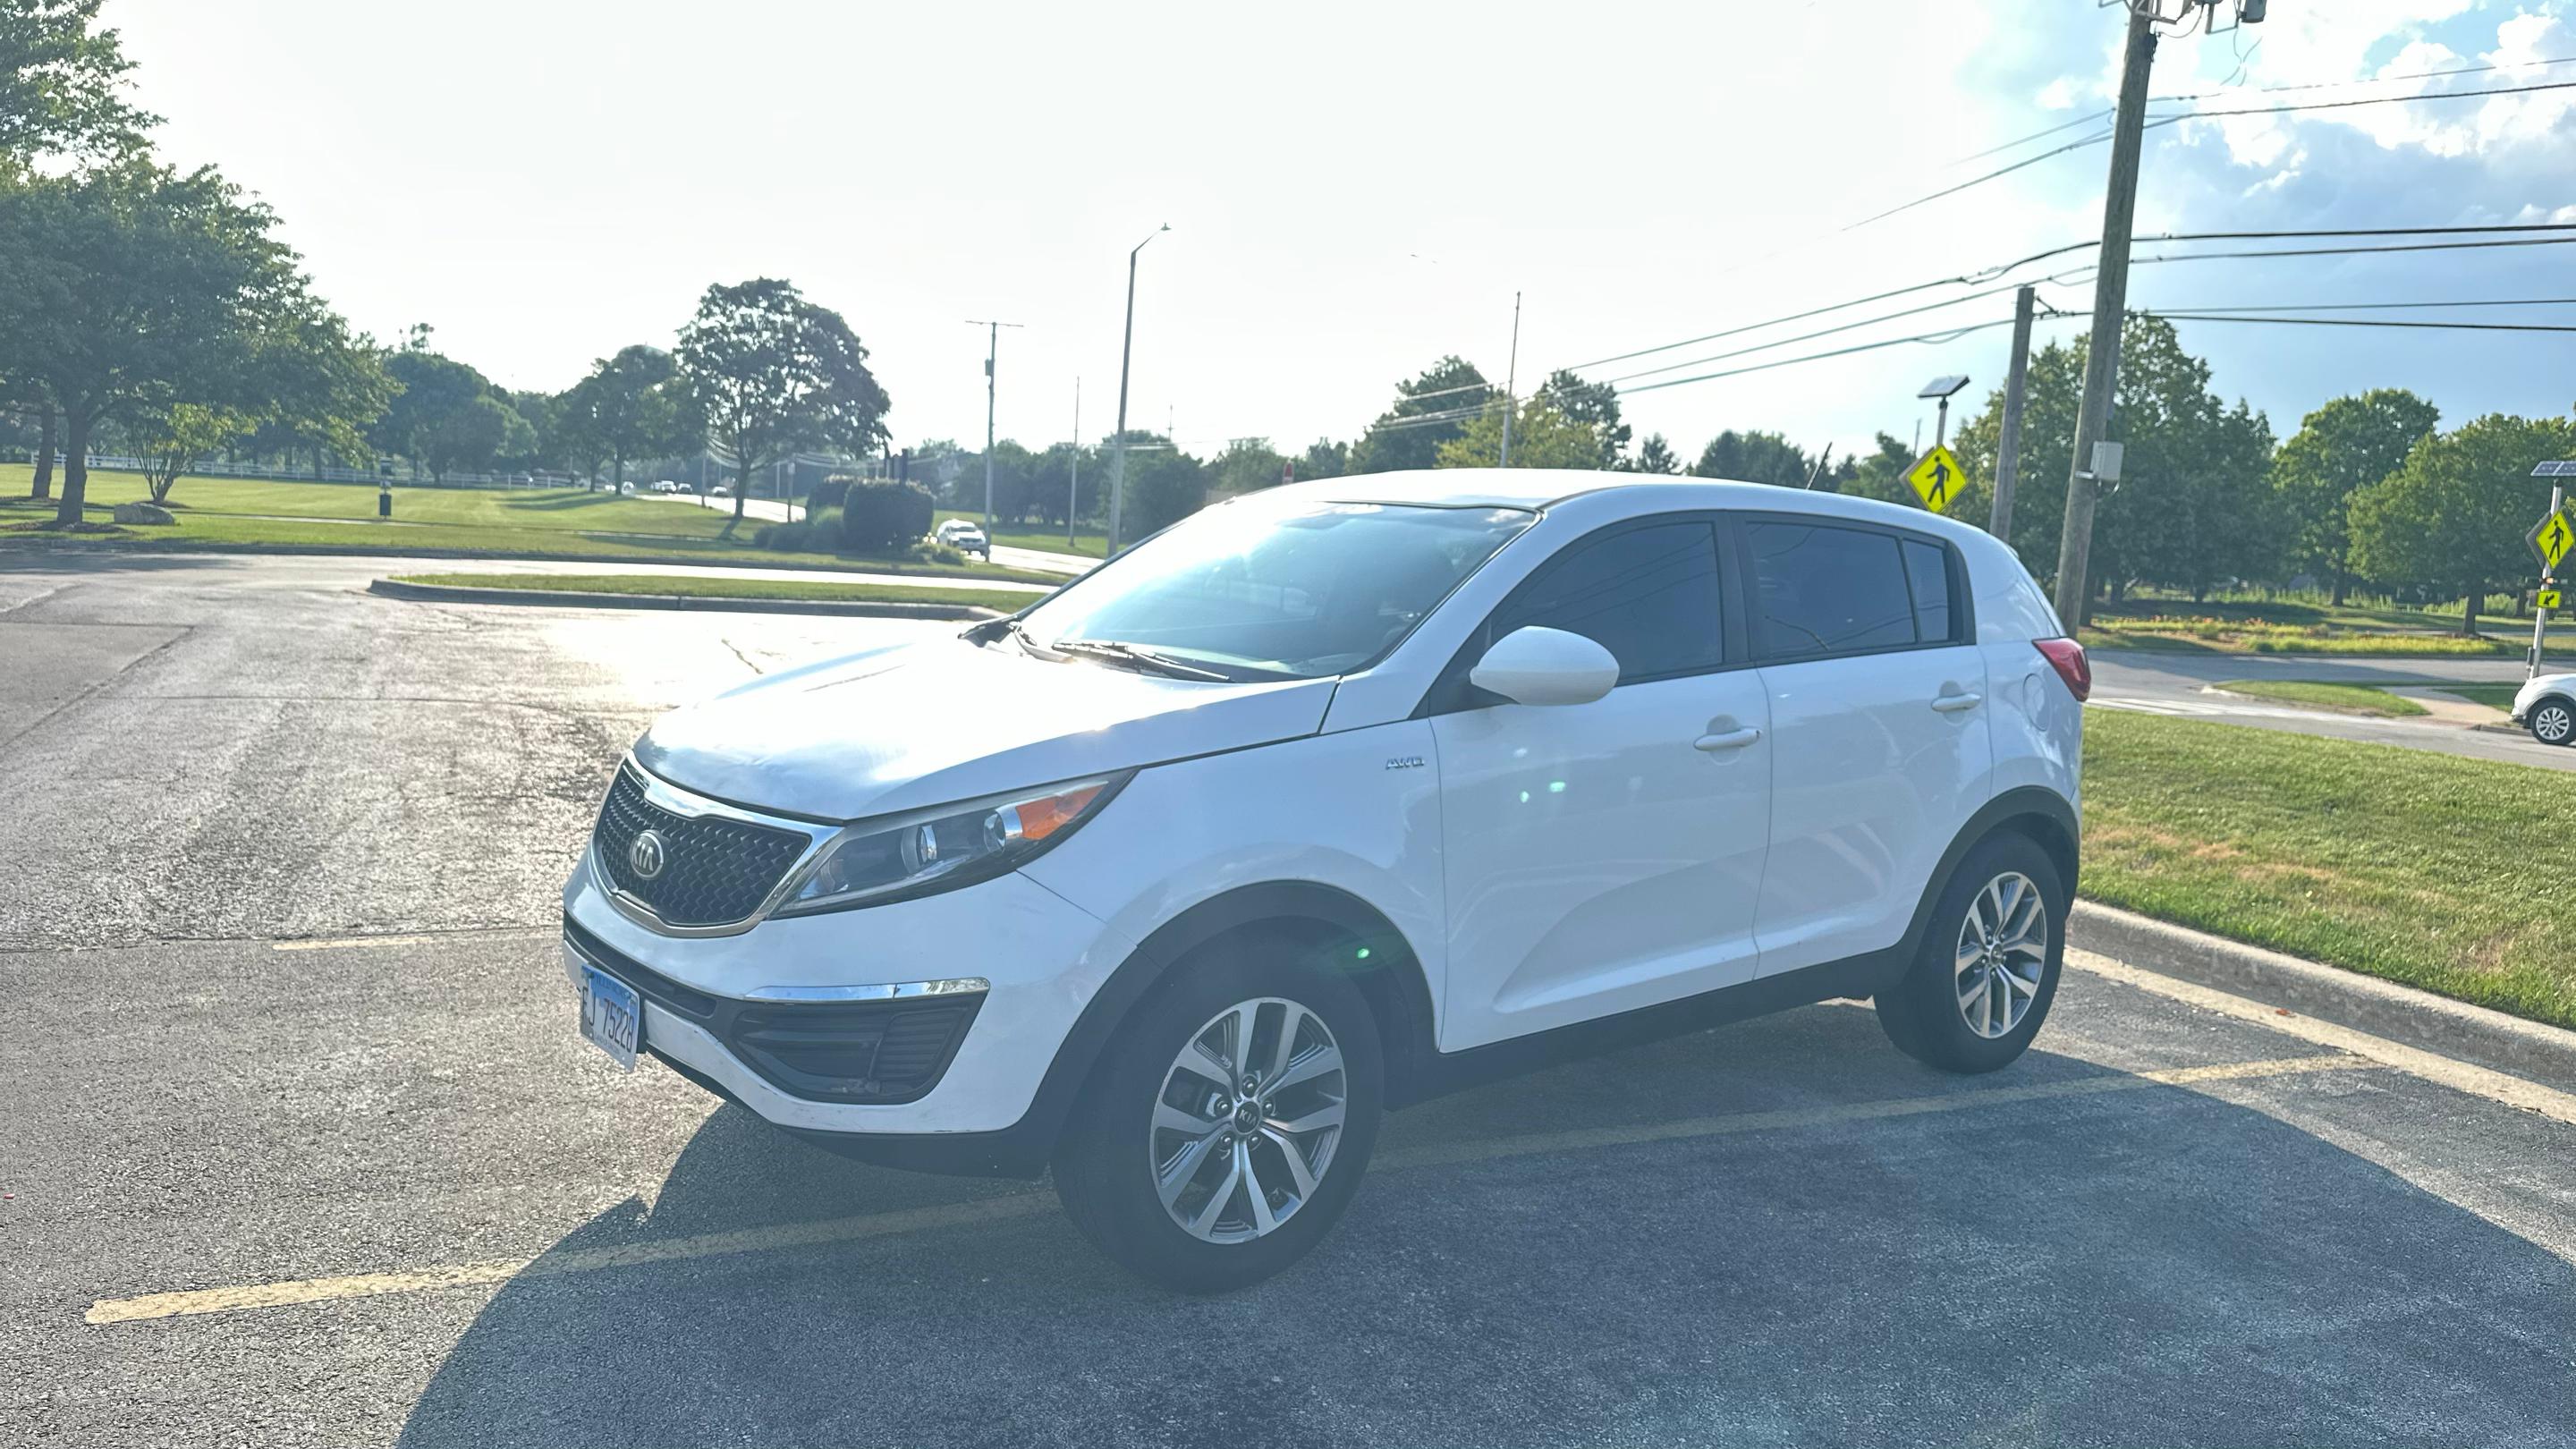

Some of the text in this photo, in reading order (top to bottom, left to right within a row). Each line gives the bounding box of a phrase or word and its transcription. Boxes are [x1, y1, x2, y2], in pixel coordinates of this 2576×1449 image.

[1385, 757, 1425, 770] AWD
[631, 839, 654, 872] KIA
[603, 997, 635, 1053] 75228
[1238, 1109, 1258, 1127] KIA
